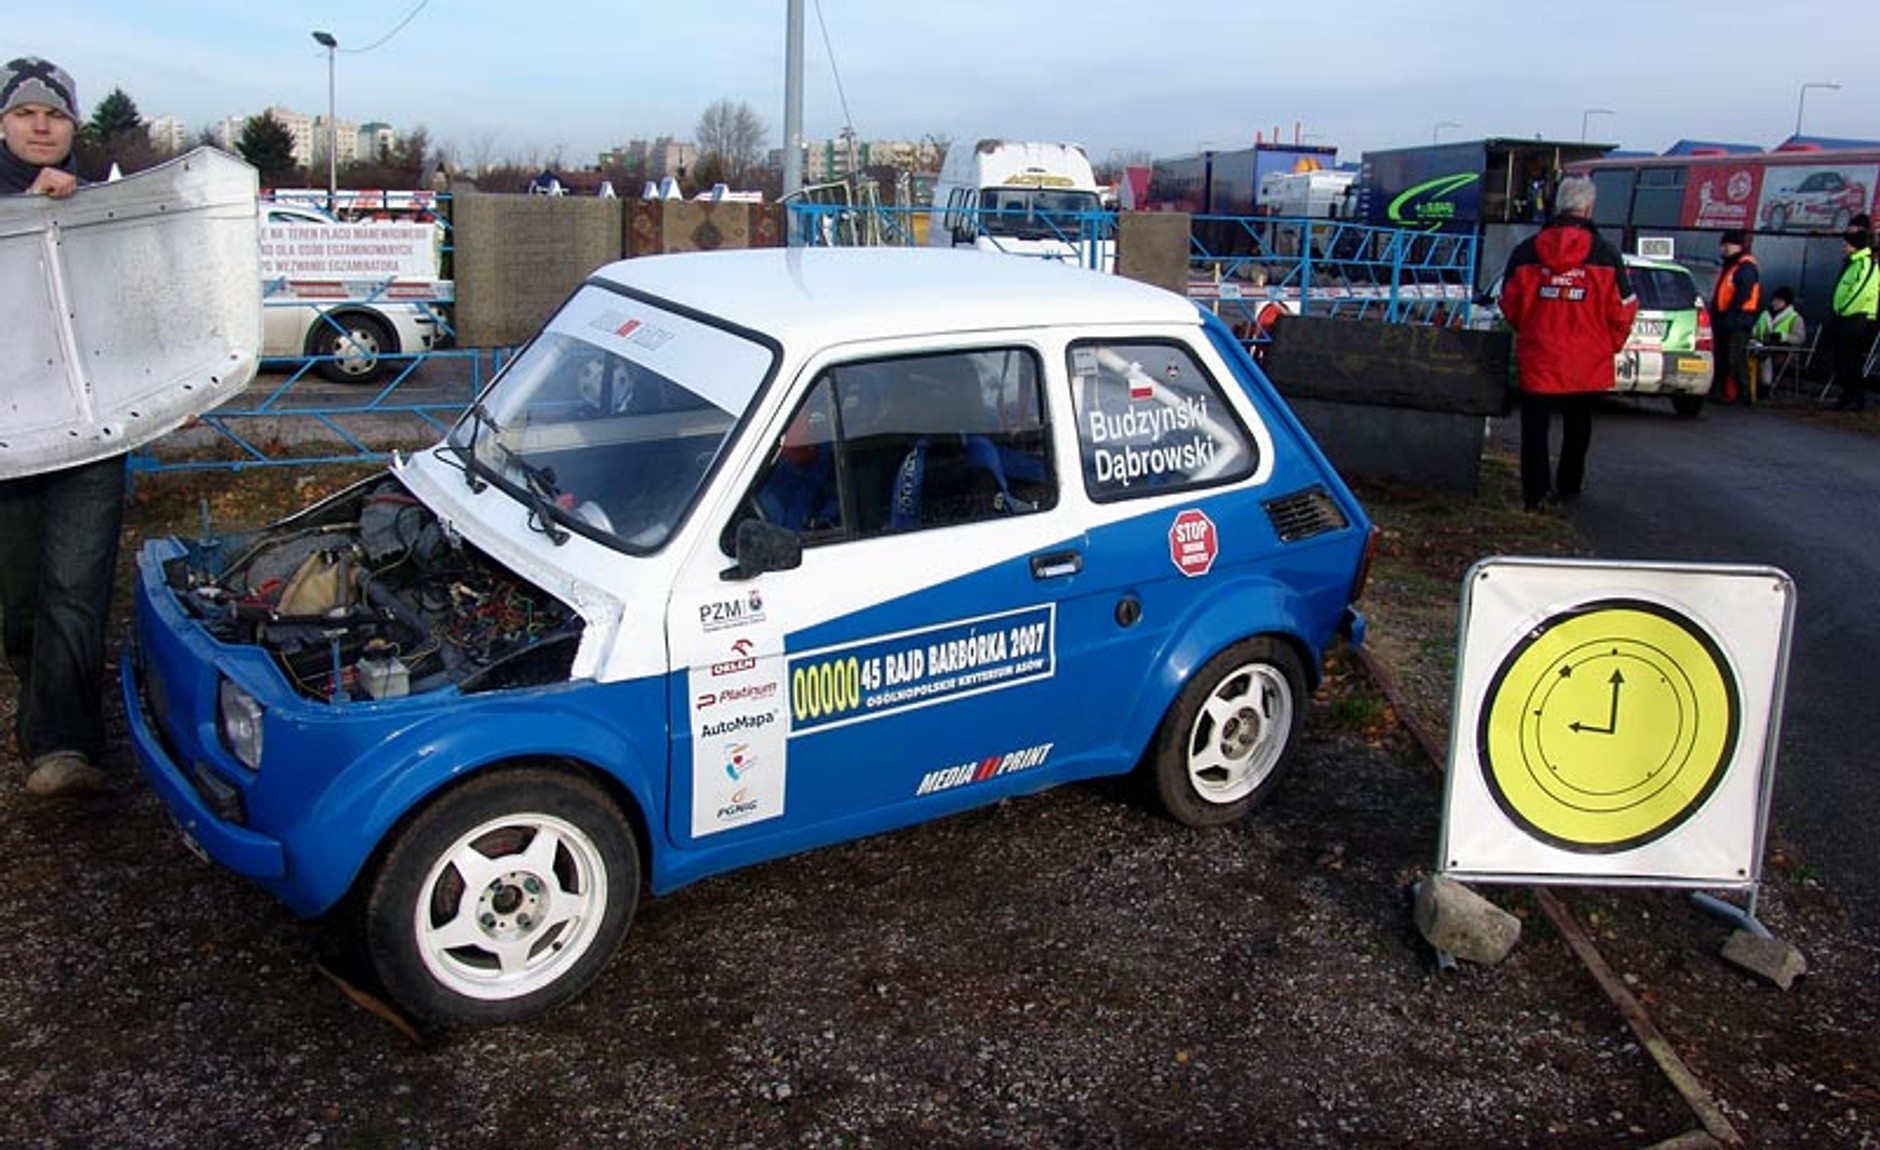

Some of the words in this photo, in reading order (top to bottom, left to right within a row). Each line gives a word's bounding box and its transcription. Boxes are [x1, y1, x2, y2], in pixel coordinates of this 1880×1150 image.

[270, 229, 284, 239] NA
[288, 229, 318, 239] TEREN
[319, 229, 350, 239] PLACU
[273, 245, 295, 255] DLA
[1095, 435, 1216, 487] Dąbrowski
[1175, 520, 1208, 542] STOP
[700, 599, 742, 622] PZM
[714, 659, 755, 675] ORLEN
[793, 656, 860, 721] 00000
[861, 658, 881, 690] 45
[886, 648, 925, 686] RAJD
[928, 627, 1007, 677] BARBÓRKA
[1010, 623, 1046, 658] 2007
[719, 682, 777, 703] Platinum
[915, 761, 979, 796] MEDIA
[996, 742, 1054, 775] PRINT
